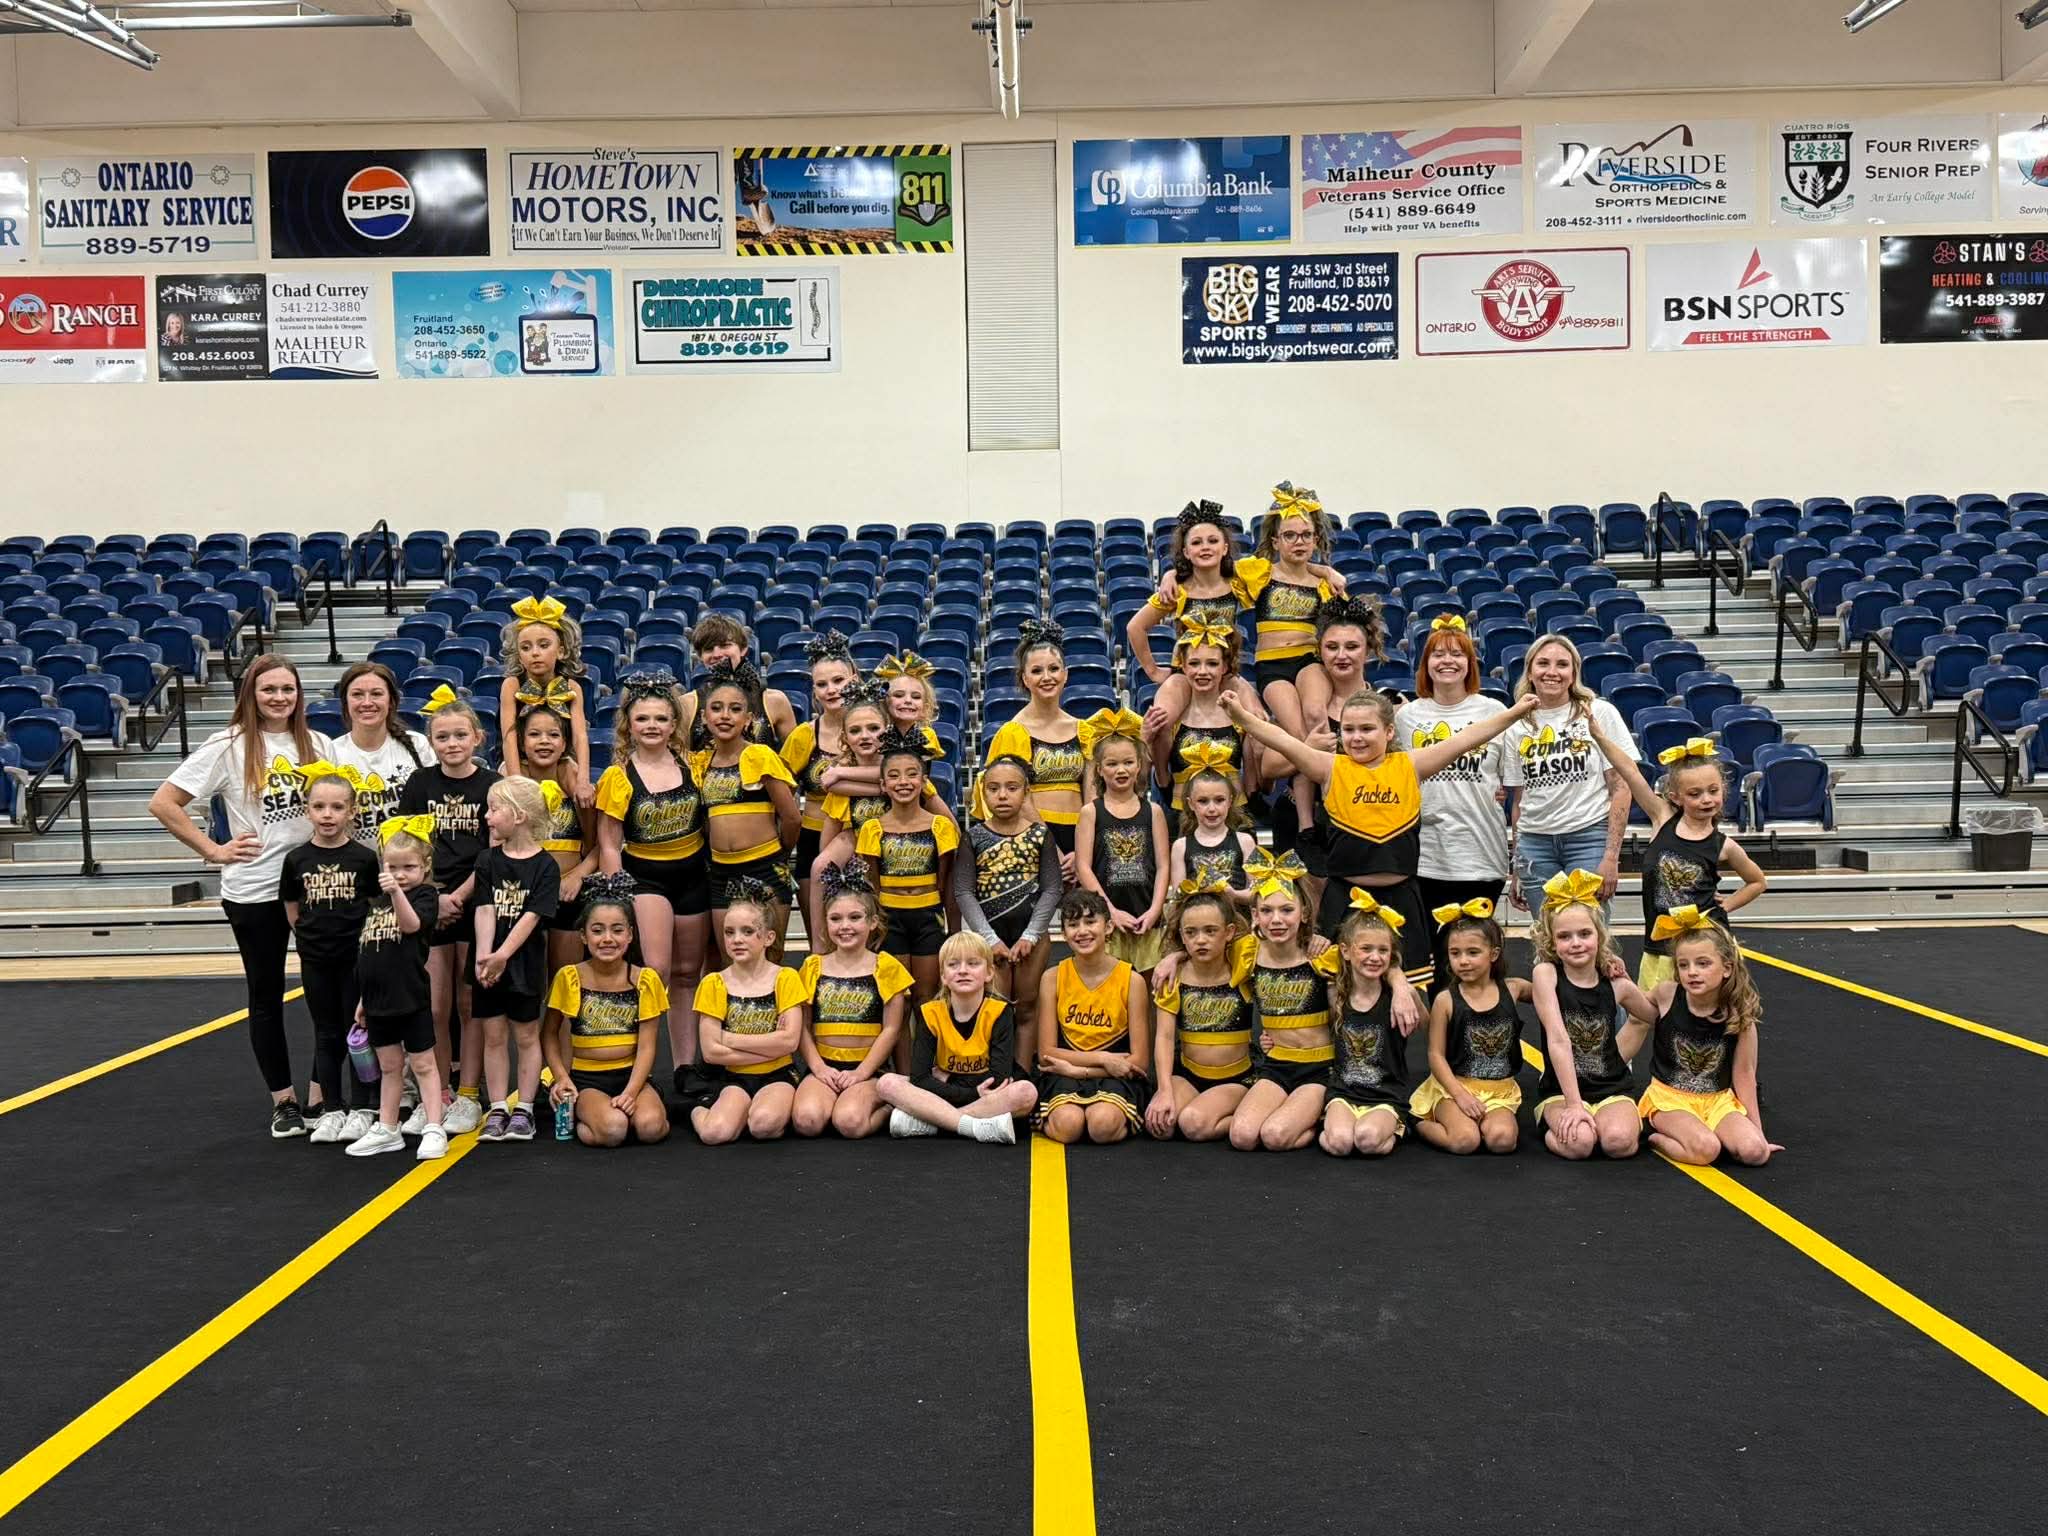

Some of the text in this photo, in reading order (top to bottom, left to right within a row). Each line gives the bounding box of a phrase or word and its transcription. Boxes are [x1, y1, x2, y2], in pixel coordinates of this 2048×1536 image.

[1866, 138, 1980, 153] FOUR RIVERS
[593, 147, 636, 160] Steve's
[98, 161, 193, 192] ONTARIO
[1327, 164, 1496, 183] Malheur County
[1865, 163, 1981, 179] SENIOR PREP
[771, 190, 797, 199] Know
[798, 189, 828, 199] what's
[903, 174, 943, 206] 811
[1318, 184, 1505, 203] Veterans Service Office
[1609, 180, 1727, 193] ORTHOPEDICS &
[347, 195, 410, 211] PEPSI
[1595, 195, 1727, 208] SPORTS MEDICINE
[1870, 190, 1976, 203] An Early College Model
[45, 196, 252, 228] SANITARY SERVICE
[512, 196, 723, 227] MOTORS, INC.
[790, 200, 890, 215] Call before you dig.
[1131, 207, 1199, 216] ColumbiaBank.com
[1349, 203, 1476, 221] (541) 889-6649
[2019, 205, 2048, 215] Servin
[1344, 220, 1480, 234] Help with your VA benefits
[1546, 212, 1747, 228] 208-452-3111 riversideorthoclinic.com
[524, 228, 537, 241] We
[539, 228, 561, 241] Can't
[562, 228, 582, 241] Earn
[584, 228, 602, 242] Your
[642, 228, 654, 241] We
[656, 228, 677, 241] Don't
[679, 228, 709, 241] Deserve
[86, 236, 211, 255] 889-5719
[1959, 242, 2025, 262] STAN'S
[1292, 262, 1388, 276] 245 SW 3rd Street
[1493, 264, 1553, 288] ART'S SERVICE
[1208, 265, 1259, 294] BIG
[1289, 275, 1390, 290] Fruitland, ID 83619
[1506, 275, 1539, 288] TOWING
[1932, 273, 1982, 287] HEATING
[1986, 272, 1994, 285] &
[272, 283, 369, 300] Chad Currey
[643, 278, 764, 297] DINSMORE
[1265, 266, 1280, 324] WEAR
[280, 302, 361, 312] 541-212-3880
[1207, 293, 1259, 322] SKY
[1288, 294, 1392, 313] 208-452-5070
[1505, 286, 1540, 323] A
[1946, 293, 2045, 307] 541-889-3987
[641, 297, 793, 327] CHIROPRACTIC
[1664, 295, 1731, 322] BSN
[49, 303, 138, 333] RANCH
[191, 312, 261, 321] KARA CURREY
[413, 315, 453, 323] Fruitland
[414, 325, 485, 335] 208-452-3650
[1200, 326, 1267, 341] SPORTS
[1496, 319, 1549, 337] BODY SHOP
[274, 336, 367, 350] MALHEUR
[414, 340, 447, 348] Ontario
[553, 339, 592, 347] PLUMBING
[691, 334, 706, 342] 187
[720, 333, 762, 341] OREGON
[1700, 330, 1812, 343] FEEL THE STRENGTH
[172, 352, 255, 360] 208.452.6003
[278, 351, 343, 364] REALTY
[415, 350, 486, 360] 541-889-5522
[565, 347, 589, 355] DRAIN
[1193, 341, 1391, 360] www.bigskysportswear.com
[1526, 737, 1573, 758] COMP
[1522, 755, 1585, 780] SEASON
[268, 773, 302, 788] CO
[263, 789, 303, 812] SEA
[1352, 784, 1400, 804] Jackets
[637, 797, 697, 828] Colony
[435, 818, 480, 832] THLETICS
[302, 872, 357, 891] COLONY
[305, 886, 355, 901] ATHLETICS
[1065, 1003, 1113, 1028] Jackets
